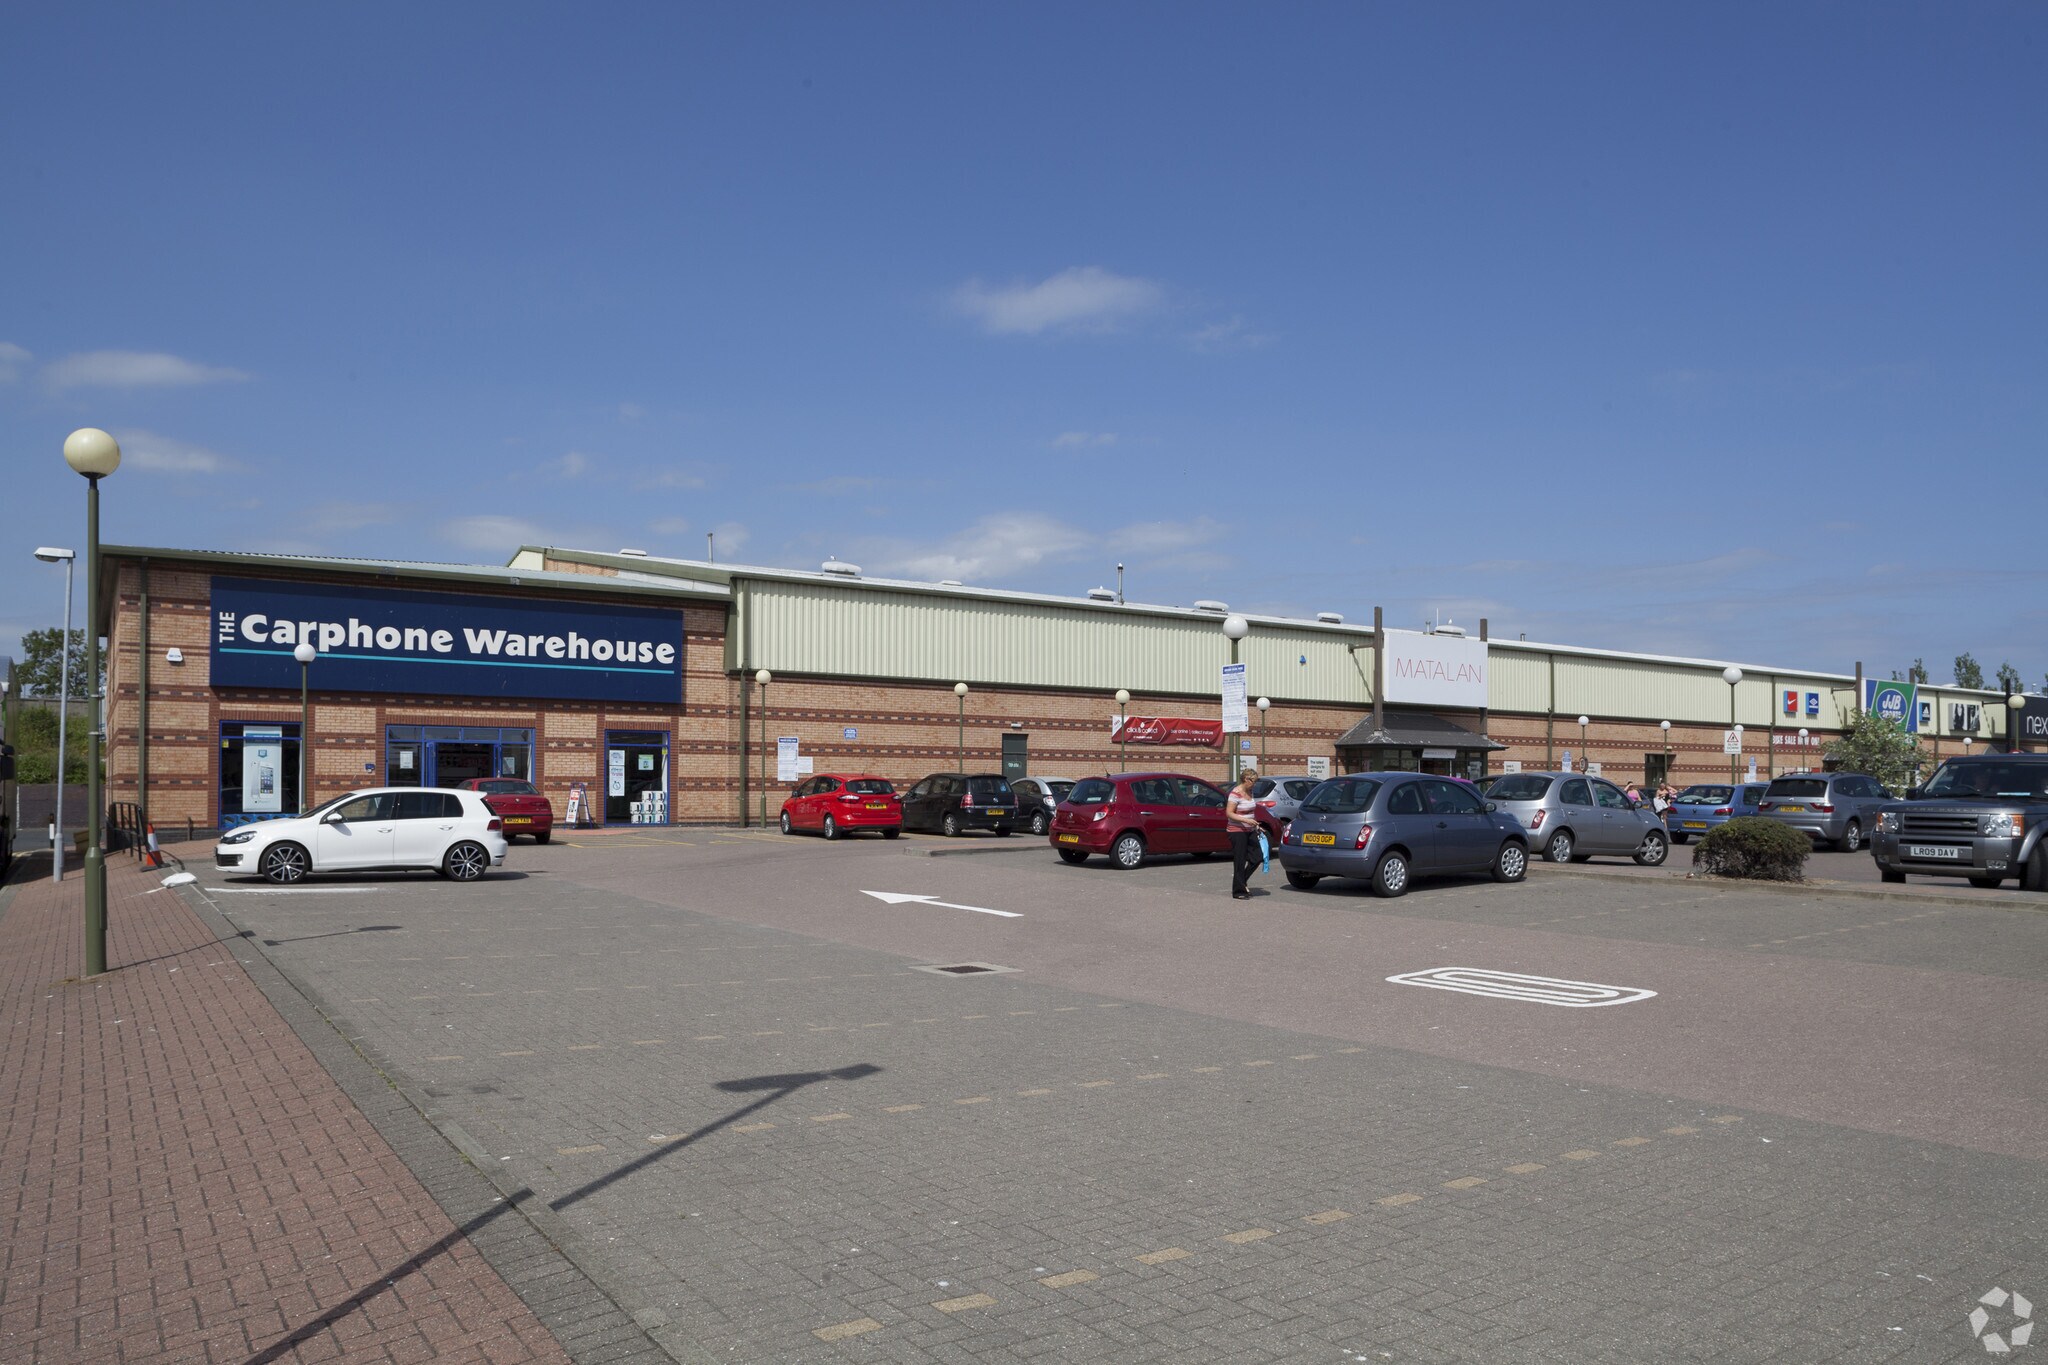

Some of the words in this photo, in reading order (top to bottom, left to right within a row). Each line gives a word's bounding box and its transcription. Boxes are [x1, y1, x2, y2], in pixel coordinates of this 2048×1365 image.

[219, 611, 235, 643] THE
[241, 614, 453, 653] Carphone
[463, 628, 675, 664] Warehouse
[1395, 657, 1482, 684] MATALAN
[1882, 694, 1902, 710] JJB
[1882, 710, 1902, 719] SPORTS
[1784, 735, 1796, 745] SALE
[1913, 847, 1935, 856] LR09
[1937, 848, 1955, 857] DAV
